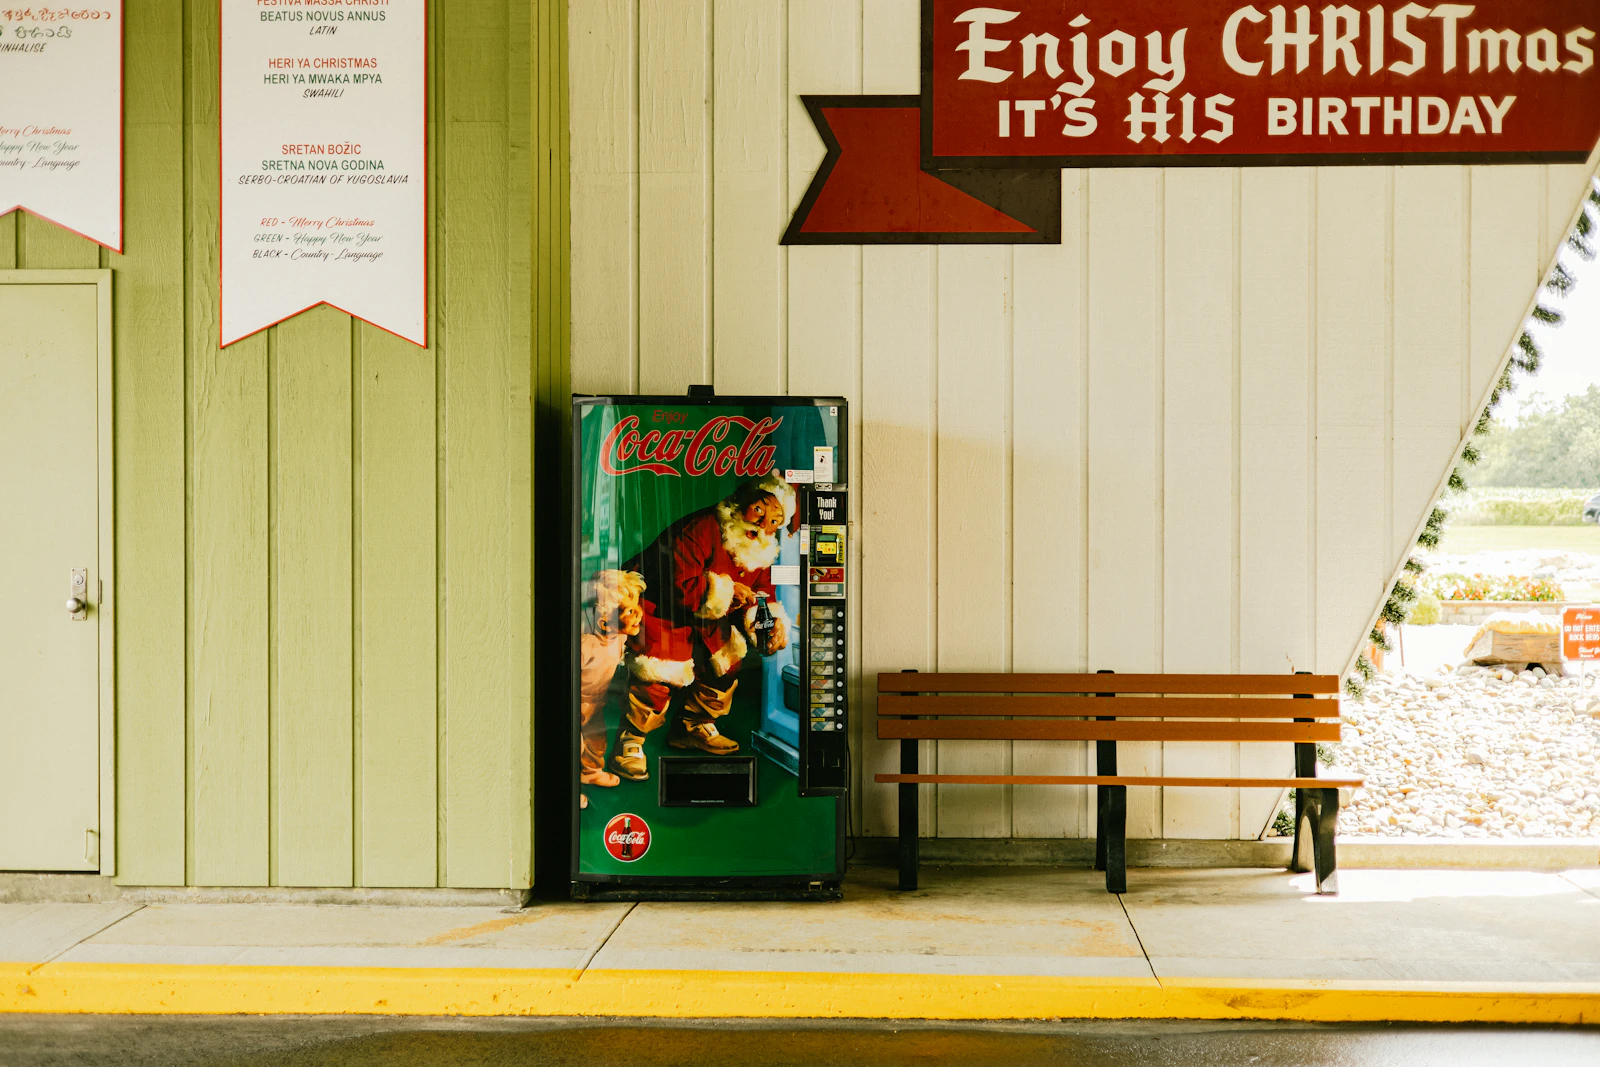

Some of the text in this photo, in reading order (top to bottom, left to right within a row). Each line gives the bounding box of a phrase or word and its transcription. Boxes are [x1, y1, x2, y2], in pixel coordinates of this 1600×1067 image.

[260, 11, 386, 22] BEATUS NOVUS ANNUS
[309, 26, 338, 35] LATIN
[953, 1, 1597, 98] Enjoy CHRISTmas
[268, 58, 378, 69] HERI YA CHRISTMAS
[263, 74, 382, 84] HERI YA MWAKA MPYA
[303, 88, 344, 98] SWAHILI
[1123, 91, 1236, 144] HIS
[1267, 95, 1518, 136] BIRTHDAY
[22, 124, 72, 137] Christmas
[26, 140, 51, 153] New
[53, 140, 80, 155] Year
[281, 141, 362, 155] SRETAN BOŽIC
[261, 160, 385, 170] SRETNA NOVA GODINA
[237, 174, 409, 185] SERBO-CROATIAN OF YUGOSLAVIA
[260, 218, 279, 227] RED
[288, 216, 324, 230] Merry
[325, 216, 376, 229] Christmas
[253, 234, 284, 243] GREEN
[293, 232, 328, 246] Happy
[329, 232, 354, 245] New
[355, 232, 384, 247] Year
[252, 250, 282, 258] BLACK
[652, 409, 689, 424] Enjoy
[599, 415, 784, 477] Coca-Cola
[817, 497, 837, 508] Thank
[819, 509, 835, 520] You!
[608, 831, 646, 844] Coca-Cola
